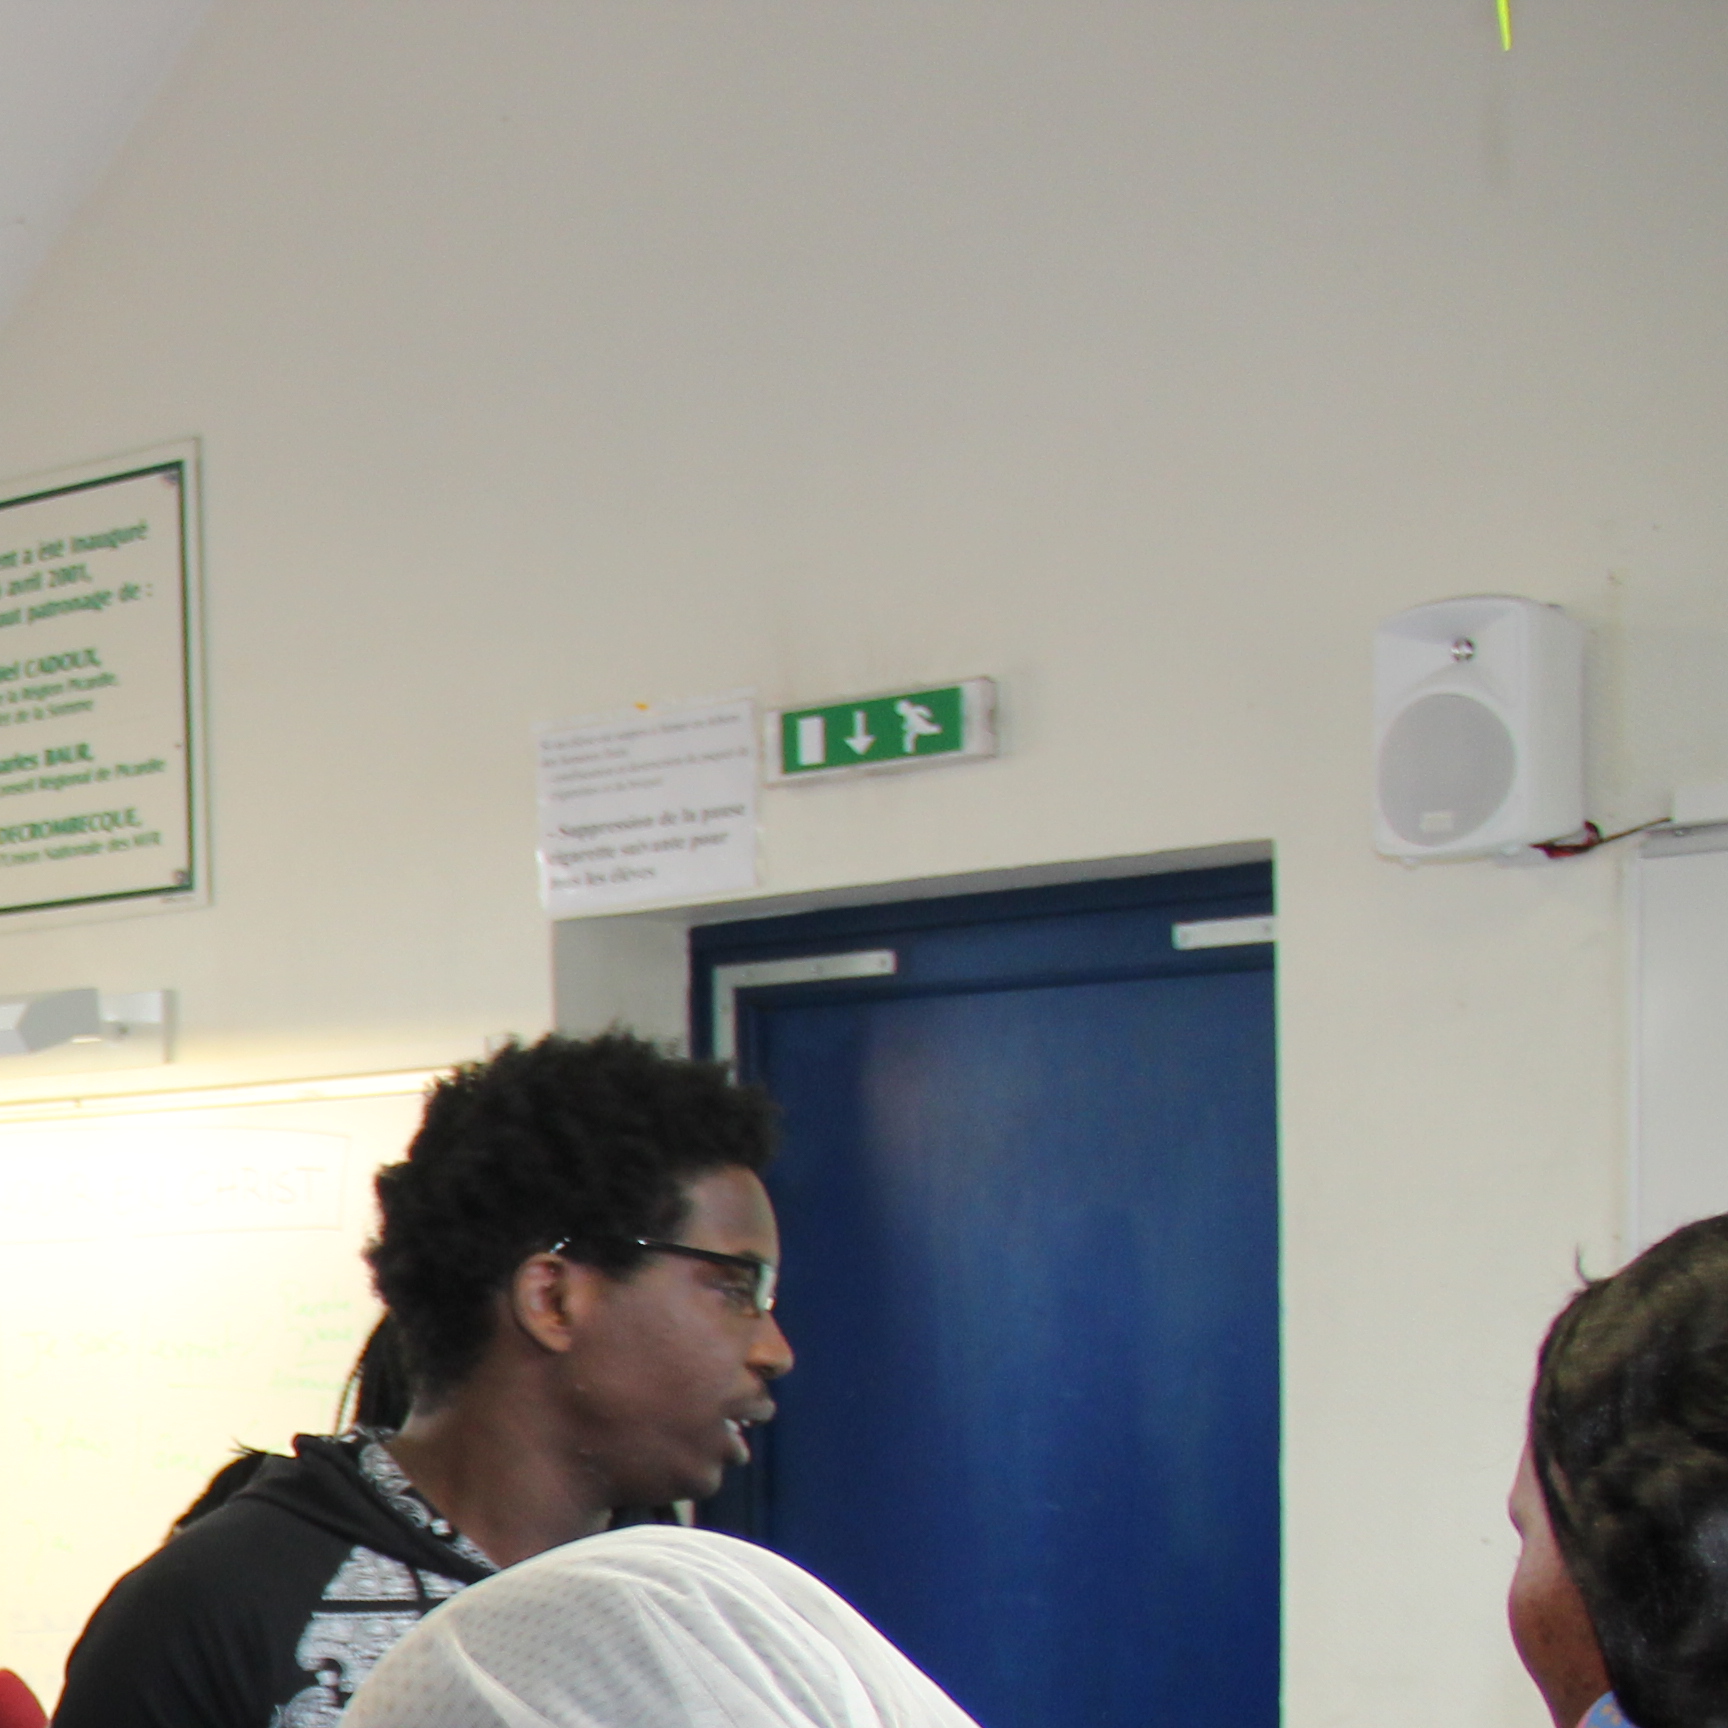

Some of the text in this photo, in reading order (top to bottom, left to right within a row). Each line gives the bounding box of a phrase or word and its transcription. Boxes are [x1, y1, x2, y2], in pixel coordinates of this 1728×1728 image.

[22, 549, 34, 565] a
[38, 538, 66, 561] été
[70, 521, 148, 552] inauguré
[9, 571, 43, 596] avril
[28, 588, 113, 624] patronage
[118, 582, 141, 602] de
[22, 682, 65, 702] Région
[15, 708, 29, 724] de
[39, 770, 92, 792] Régional
[96, 766, 112, 782] de
[558, 814, 655, 841] Suppression
[659, 809, 678, 826] de
[681, 807, 697, 824] la
[689, 832, 731, 853] pour
